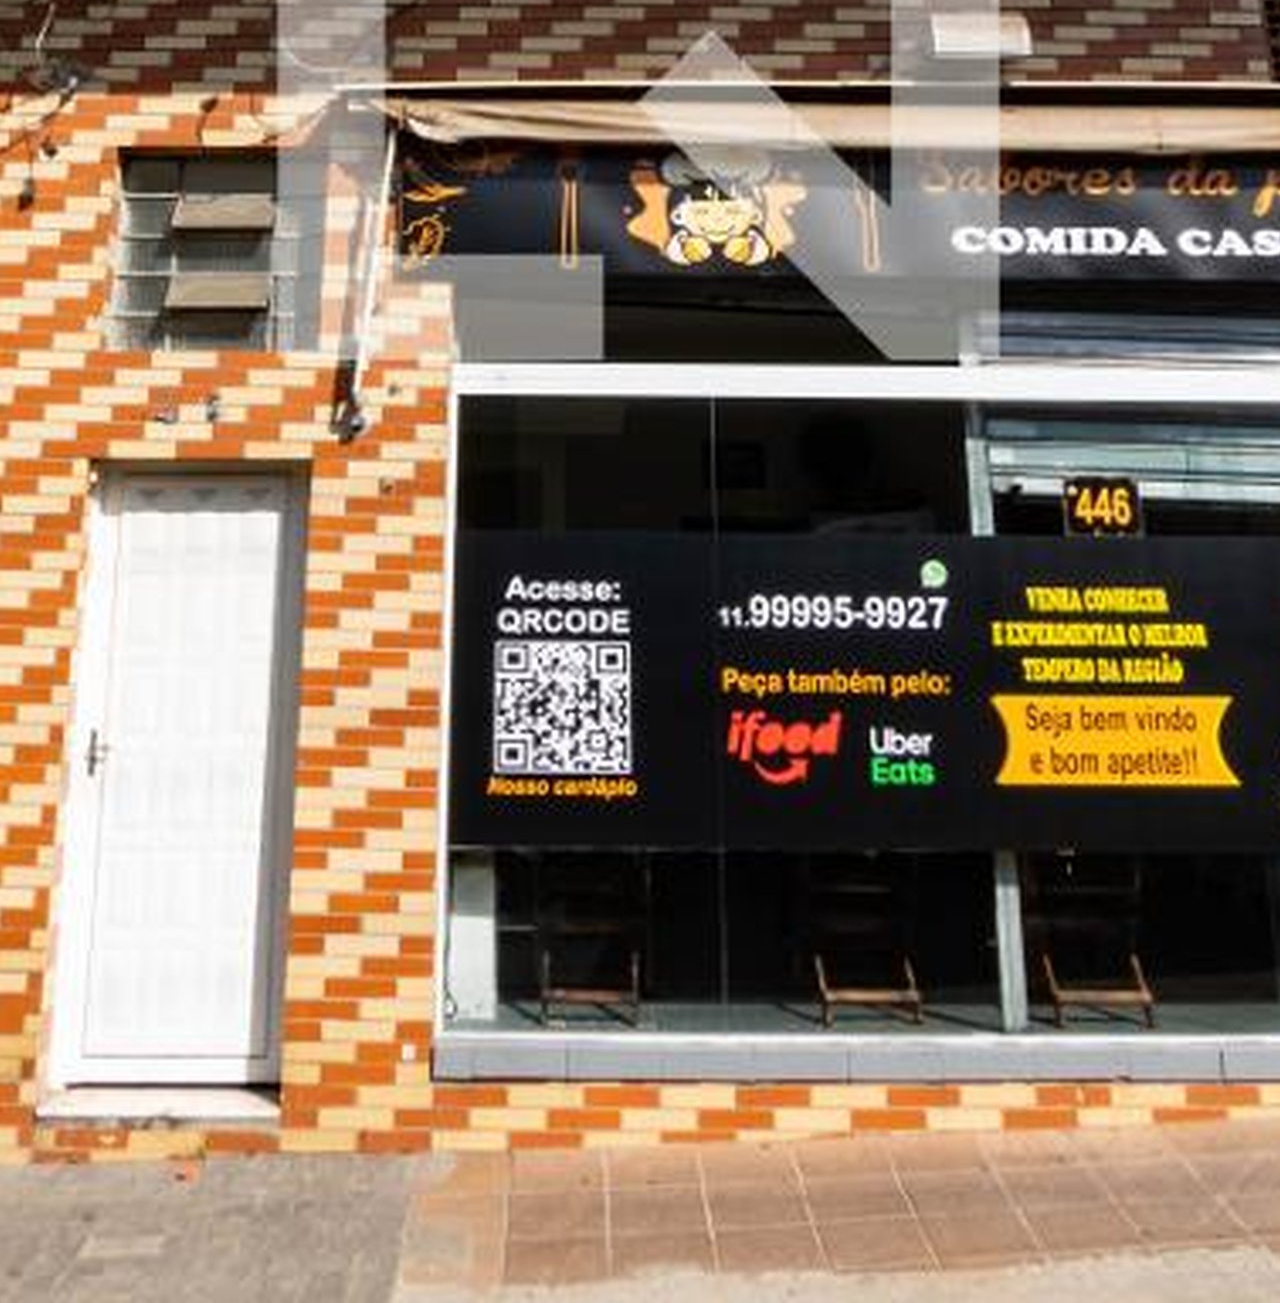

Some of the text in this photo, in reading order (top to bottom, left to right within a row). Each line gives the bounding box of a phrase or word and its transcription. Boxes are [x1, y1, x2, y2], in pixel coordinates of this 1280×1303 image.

[1166, 154, 1241, 198] da
[951, 226, 1169, 256] COMIDA
[1074, 487, 1132, 526] 446
[504, 574, 621, 601] Acesse:
[1025, 586, 1169, 612] VENHA CONHECER
[497, 608, 631, 634] QRCODE
[719, 594, 948, 630] 11.99995-9927
[721, 667, 952, 699] Peça também pelo:
[1021, 657, 1095, 682] TEMPERO
[1096, 657, 1121, 682] DA
[1024, 702, 1198, 738] Seja bem vindo
[869, 726, 933, 756] Uber
[871, 756, 936, 785] Eats
[1029, 747, 1198, 782] e bom apetite!!
[486, 776, 638, 801] Nosso cardápio
